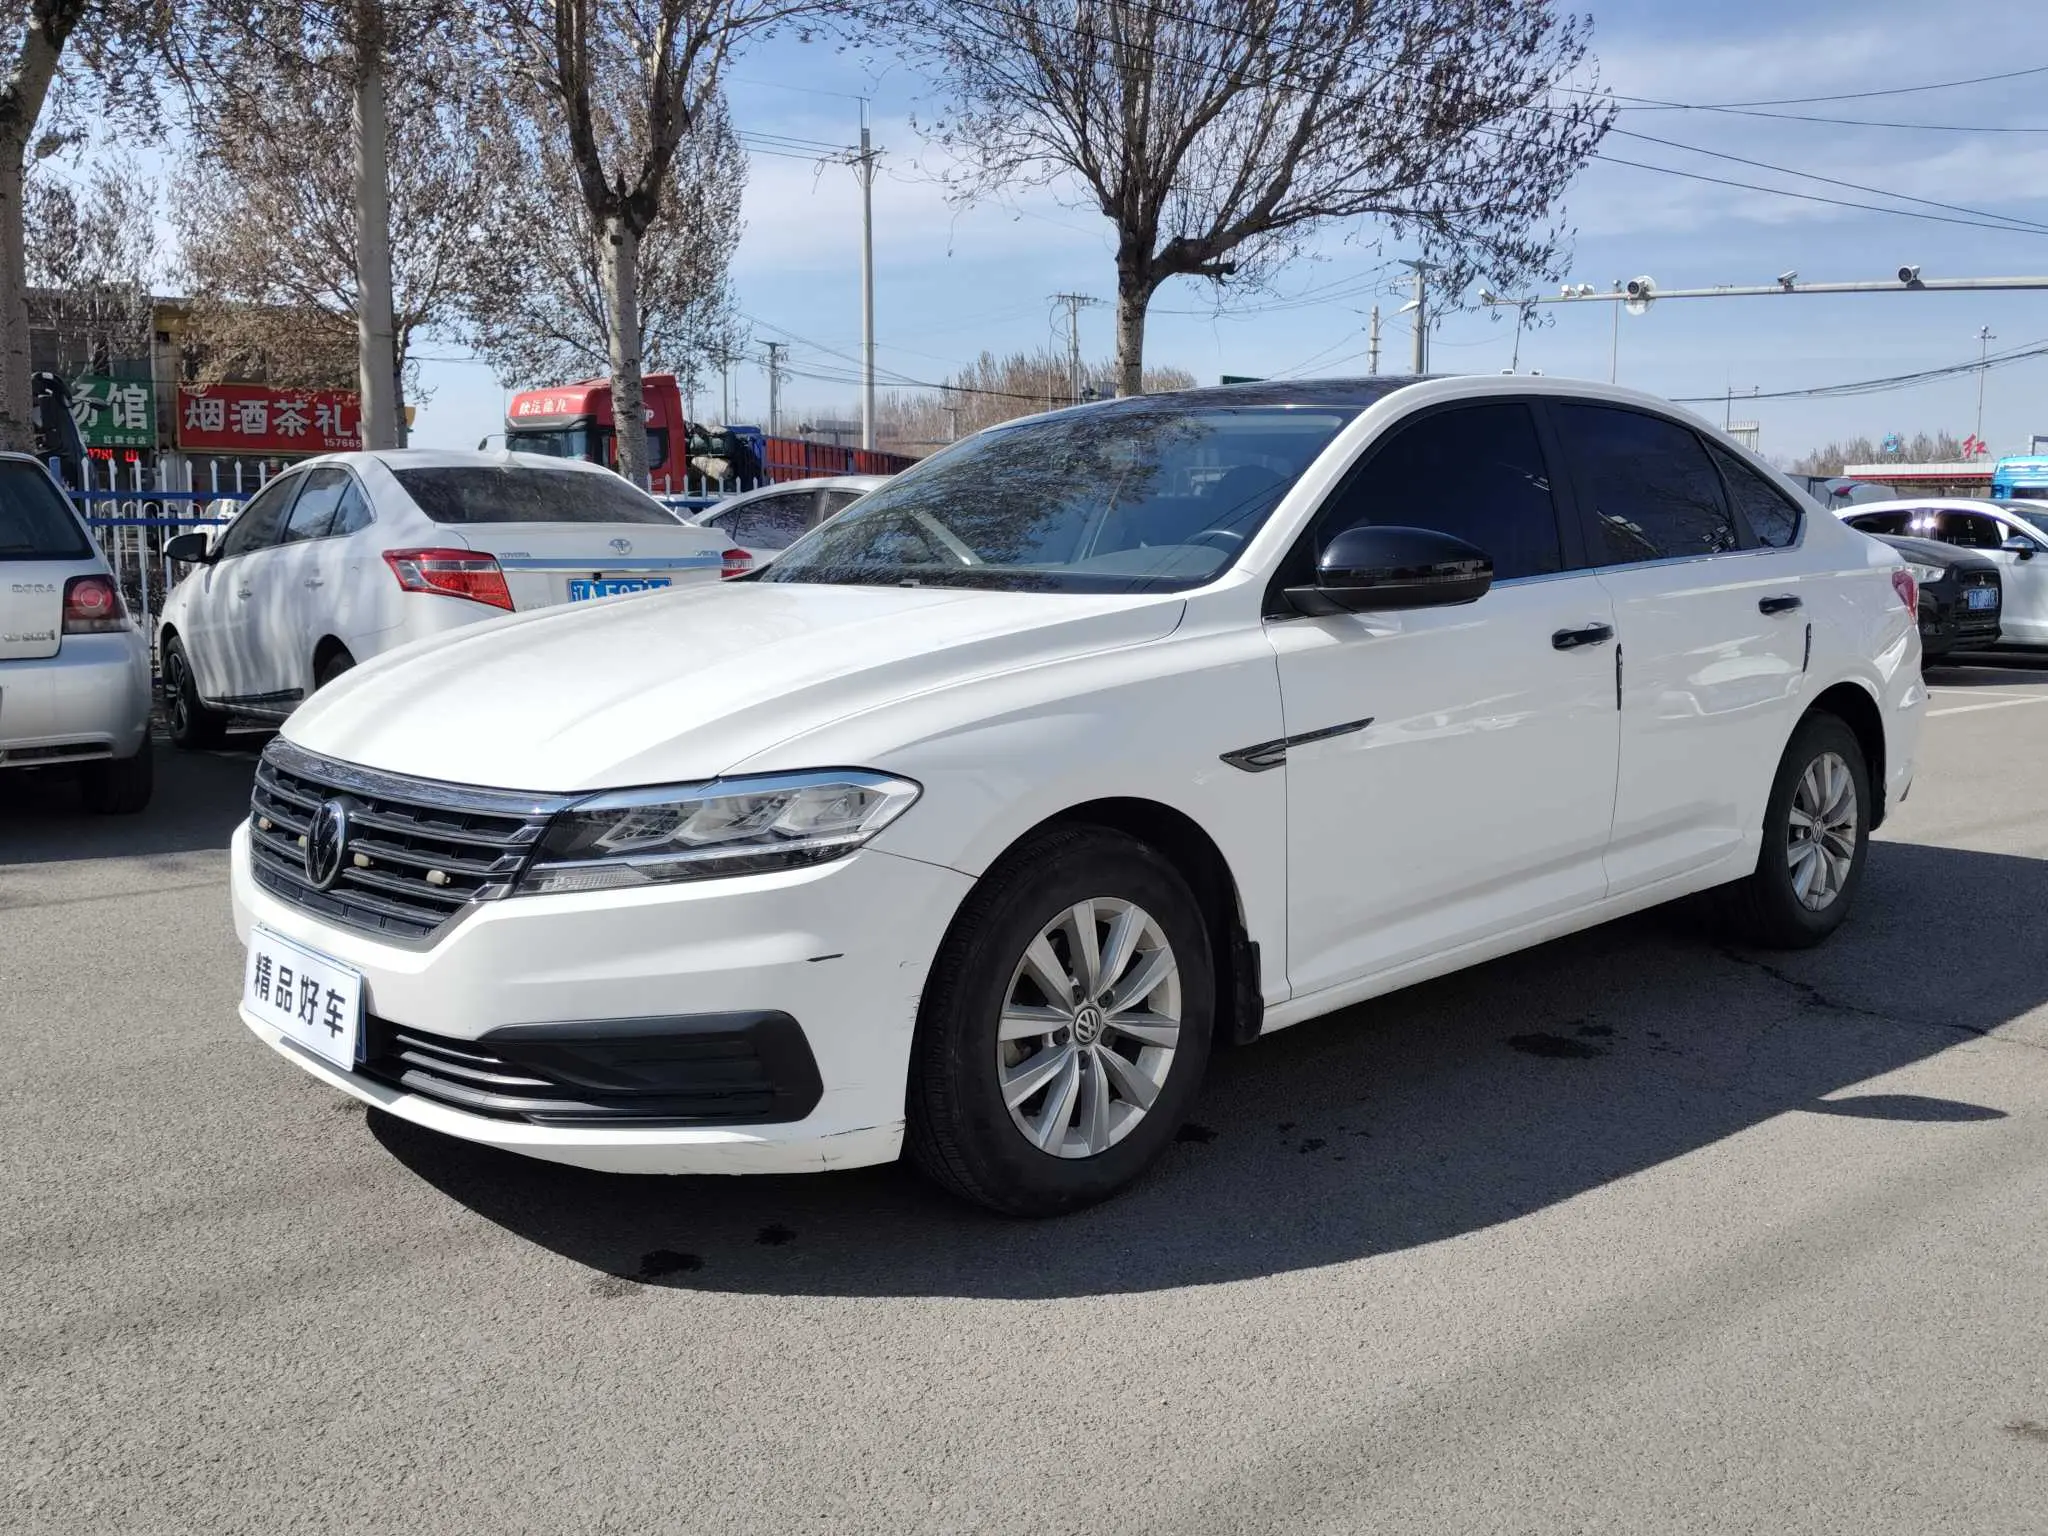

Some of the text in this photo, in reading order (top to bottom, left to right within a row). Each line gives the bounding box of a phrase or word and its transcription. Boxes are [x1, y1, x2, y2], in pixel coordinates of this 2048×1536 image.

[184, 398, 362, 437] 烟酒茶礼
[254, 951, 346, 1038] 精品好车
